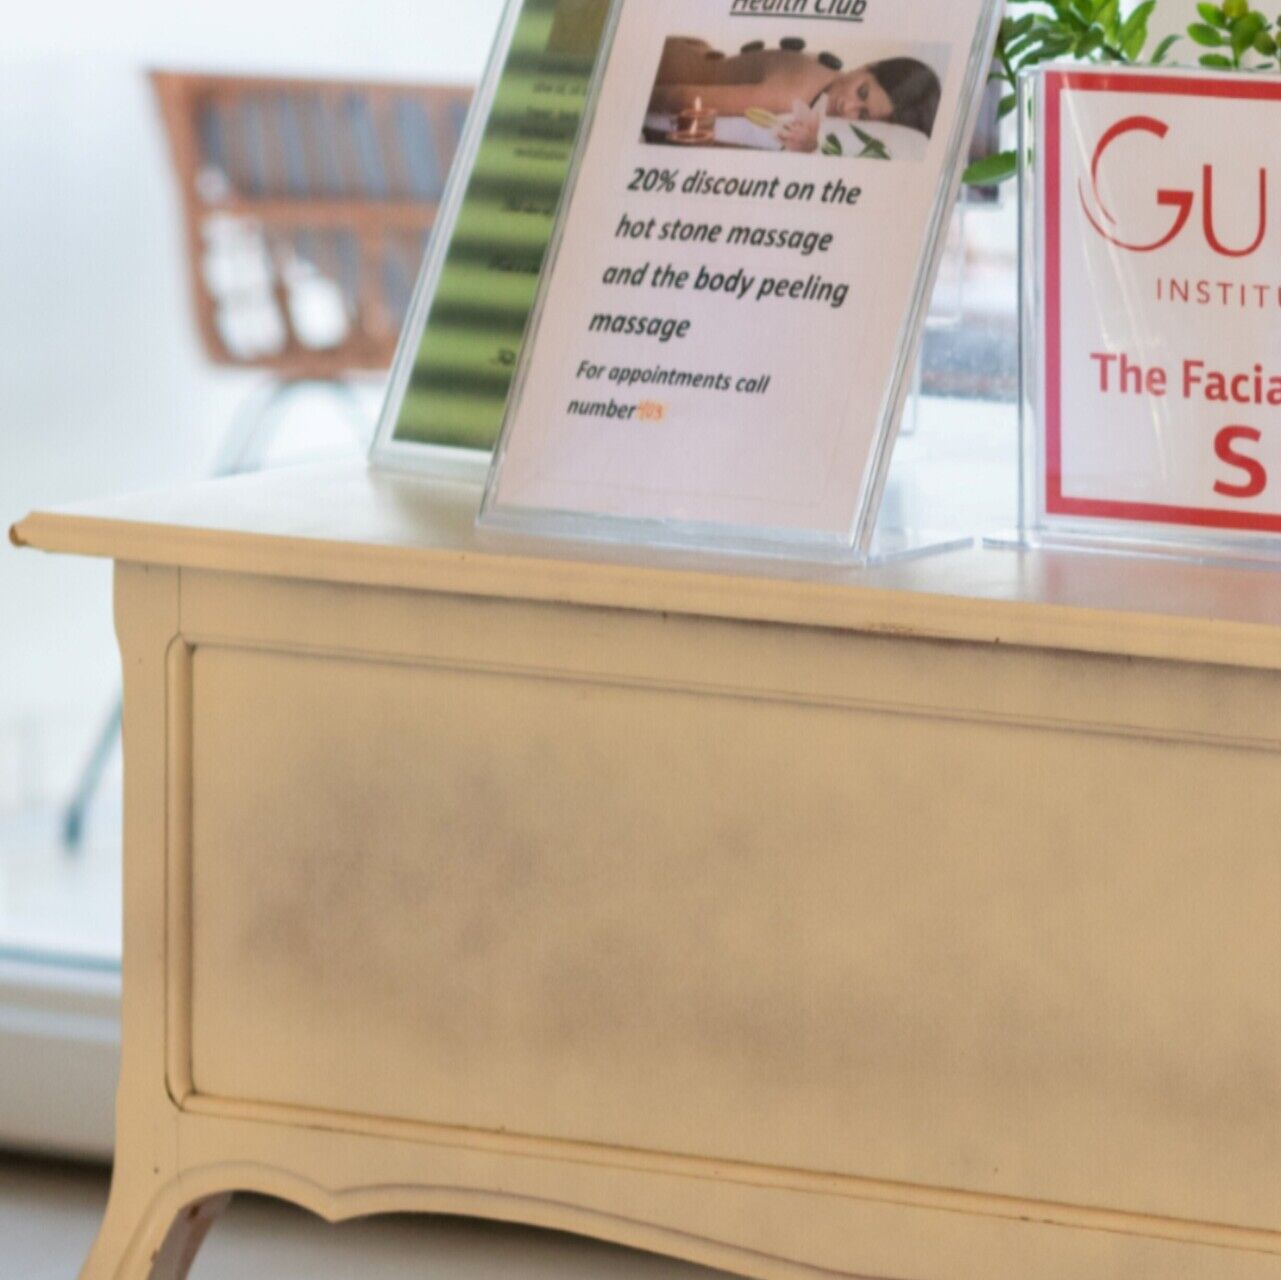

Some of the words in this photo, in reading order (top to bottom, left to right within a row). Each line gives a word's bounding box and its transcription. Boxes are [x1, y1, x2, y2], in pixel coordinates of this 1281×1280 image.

[627, 167, 678, 193] 20%
[681, 170, 780, 200] discount
[783, 180, 815, 201] on
[820, 178, 862, 206] the
[614, 214, 655, 239] hot
[657, 218, 723, 244] stone
[726, 226, 833, 256] massage
[602, 262, 650, 287] and
[650, 263, 690, 289] the
[693, 265, 755, 300] body
[756, 273, 850, 309] peeling
[588, 312, 691, 343] massage
[576, 360, 606, 380] For
[608, 365, 732, 392] appointments
[735, 374, 771, 395] call
[1090, 352, 1167, 397] The
[566, 397, 636, 420] number
